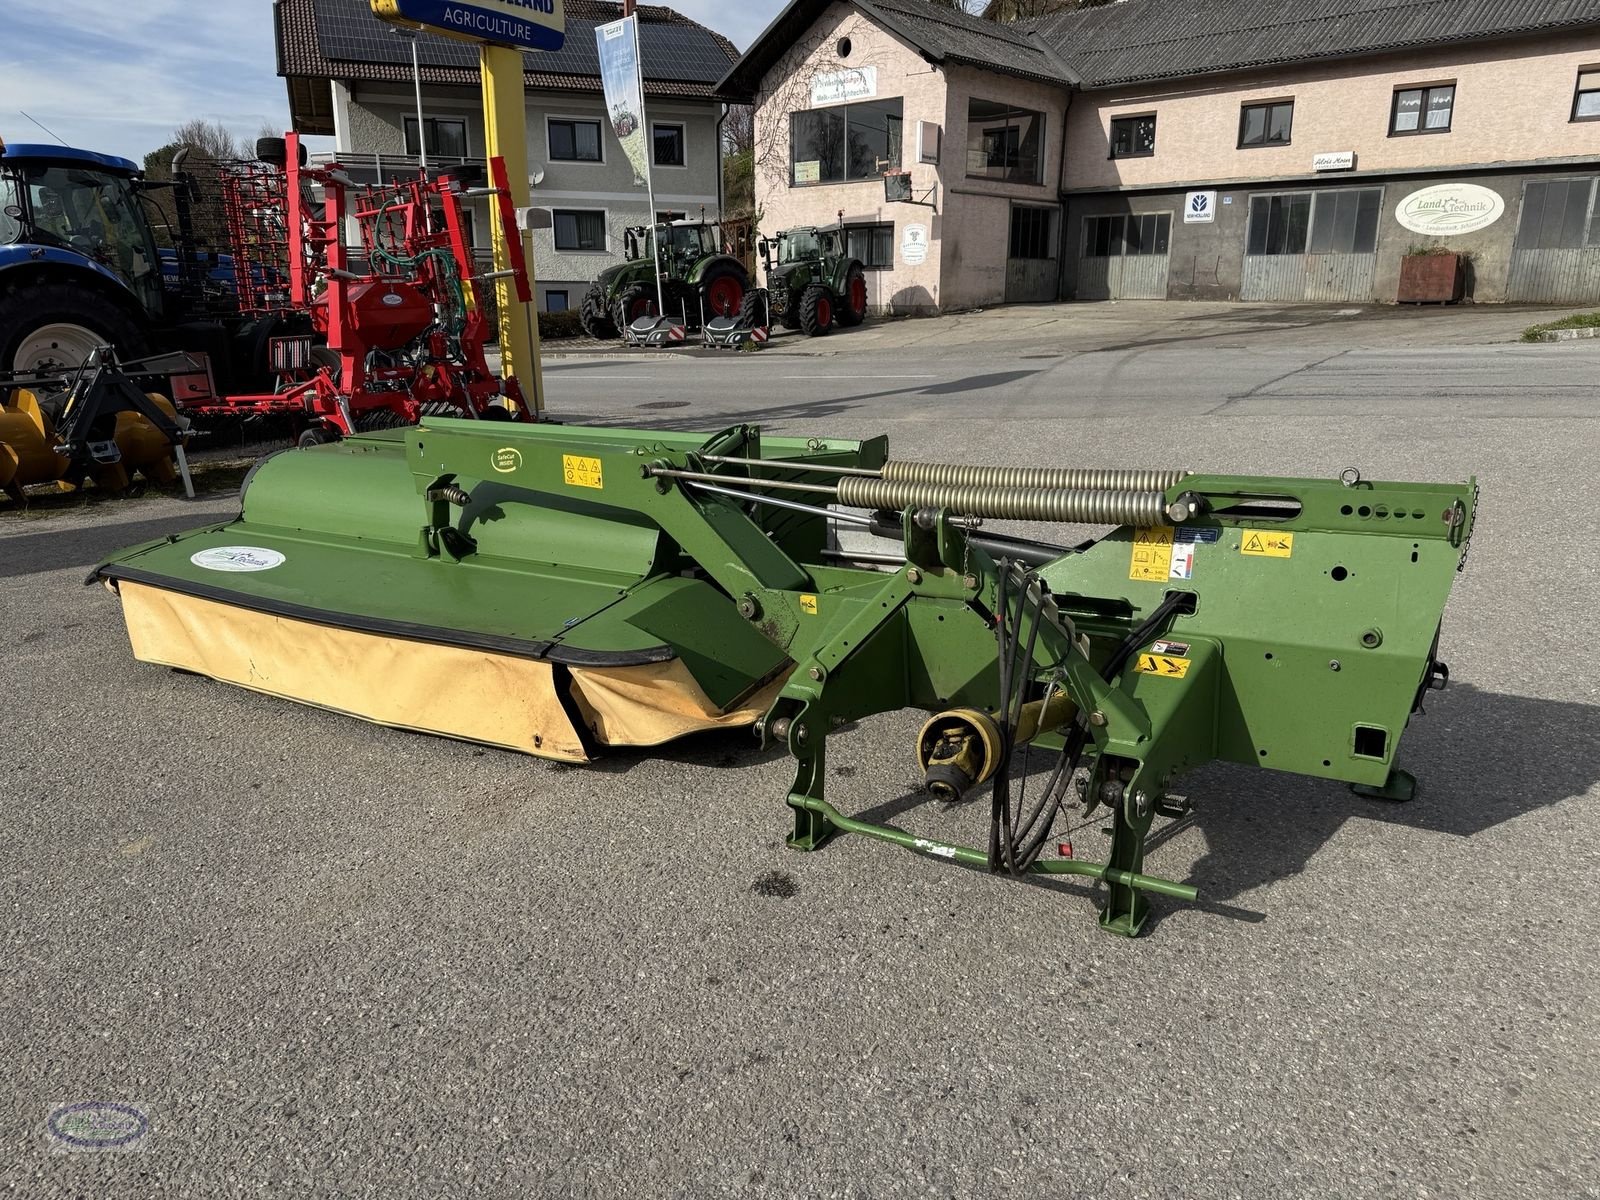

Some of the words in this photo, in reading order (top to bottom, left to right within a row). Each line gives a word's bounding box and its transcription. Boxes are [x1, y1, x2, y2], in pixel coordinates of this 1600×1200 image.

[443, 7, 531, 40] AGRICULTURE
[1417, 199, 1442, 209] Land
[1449, 202, 1487, 212] Technik
